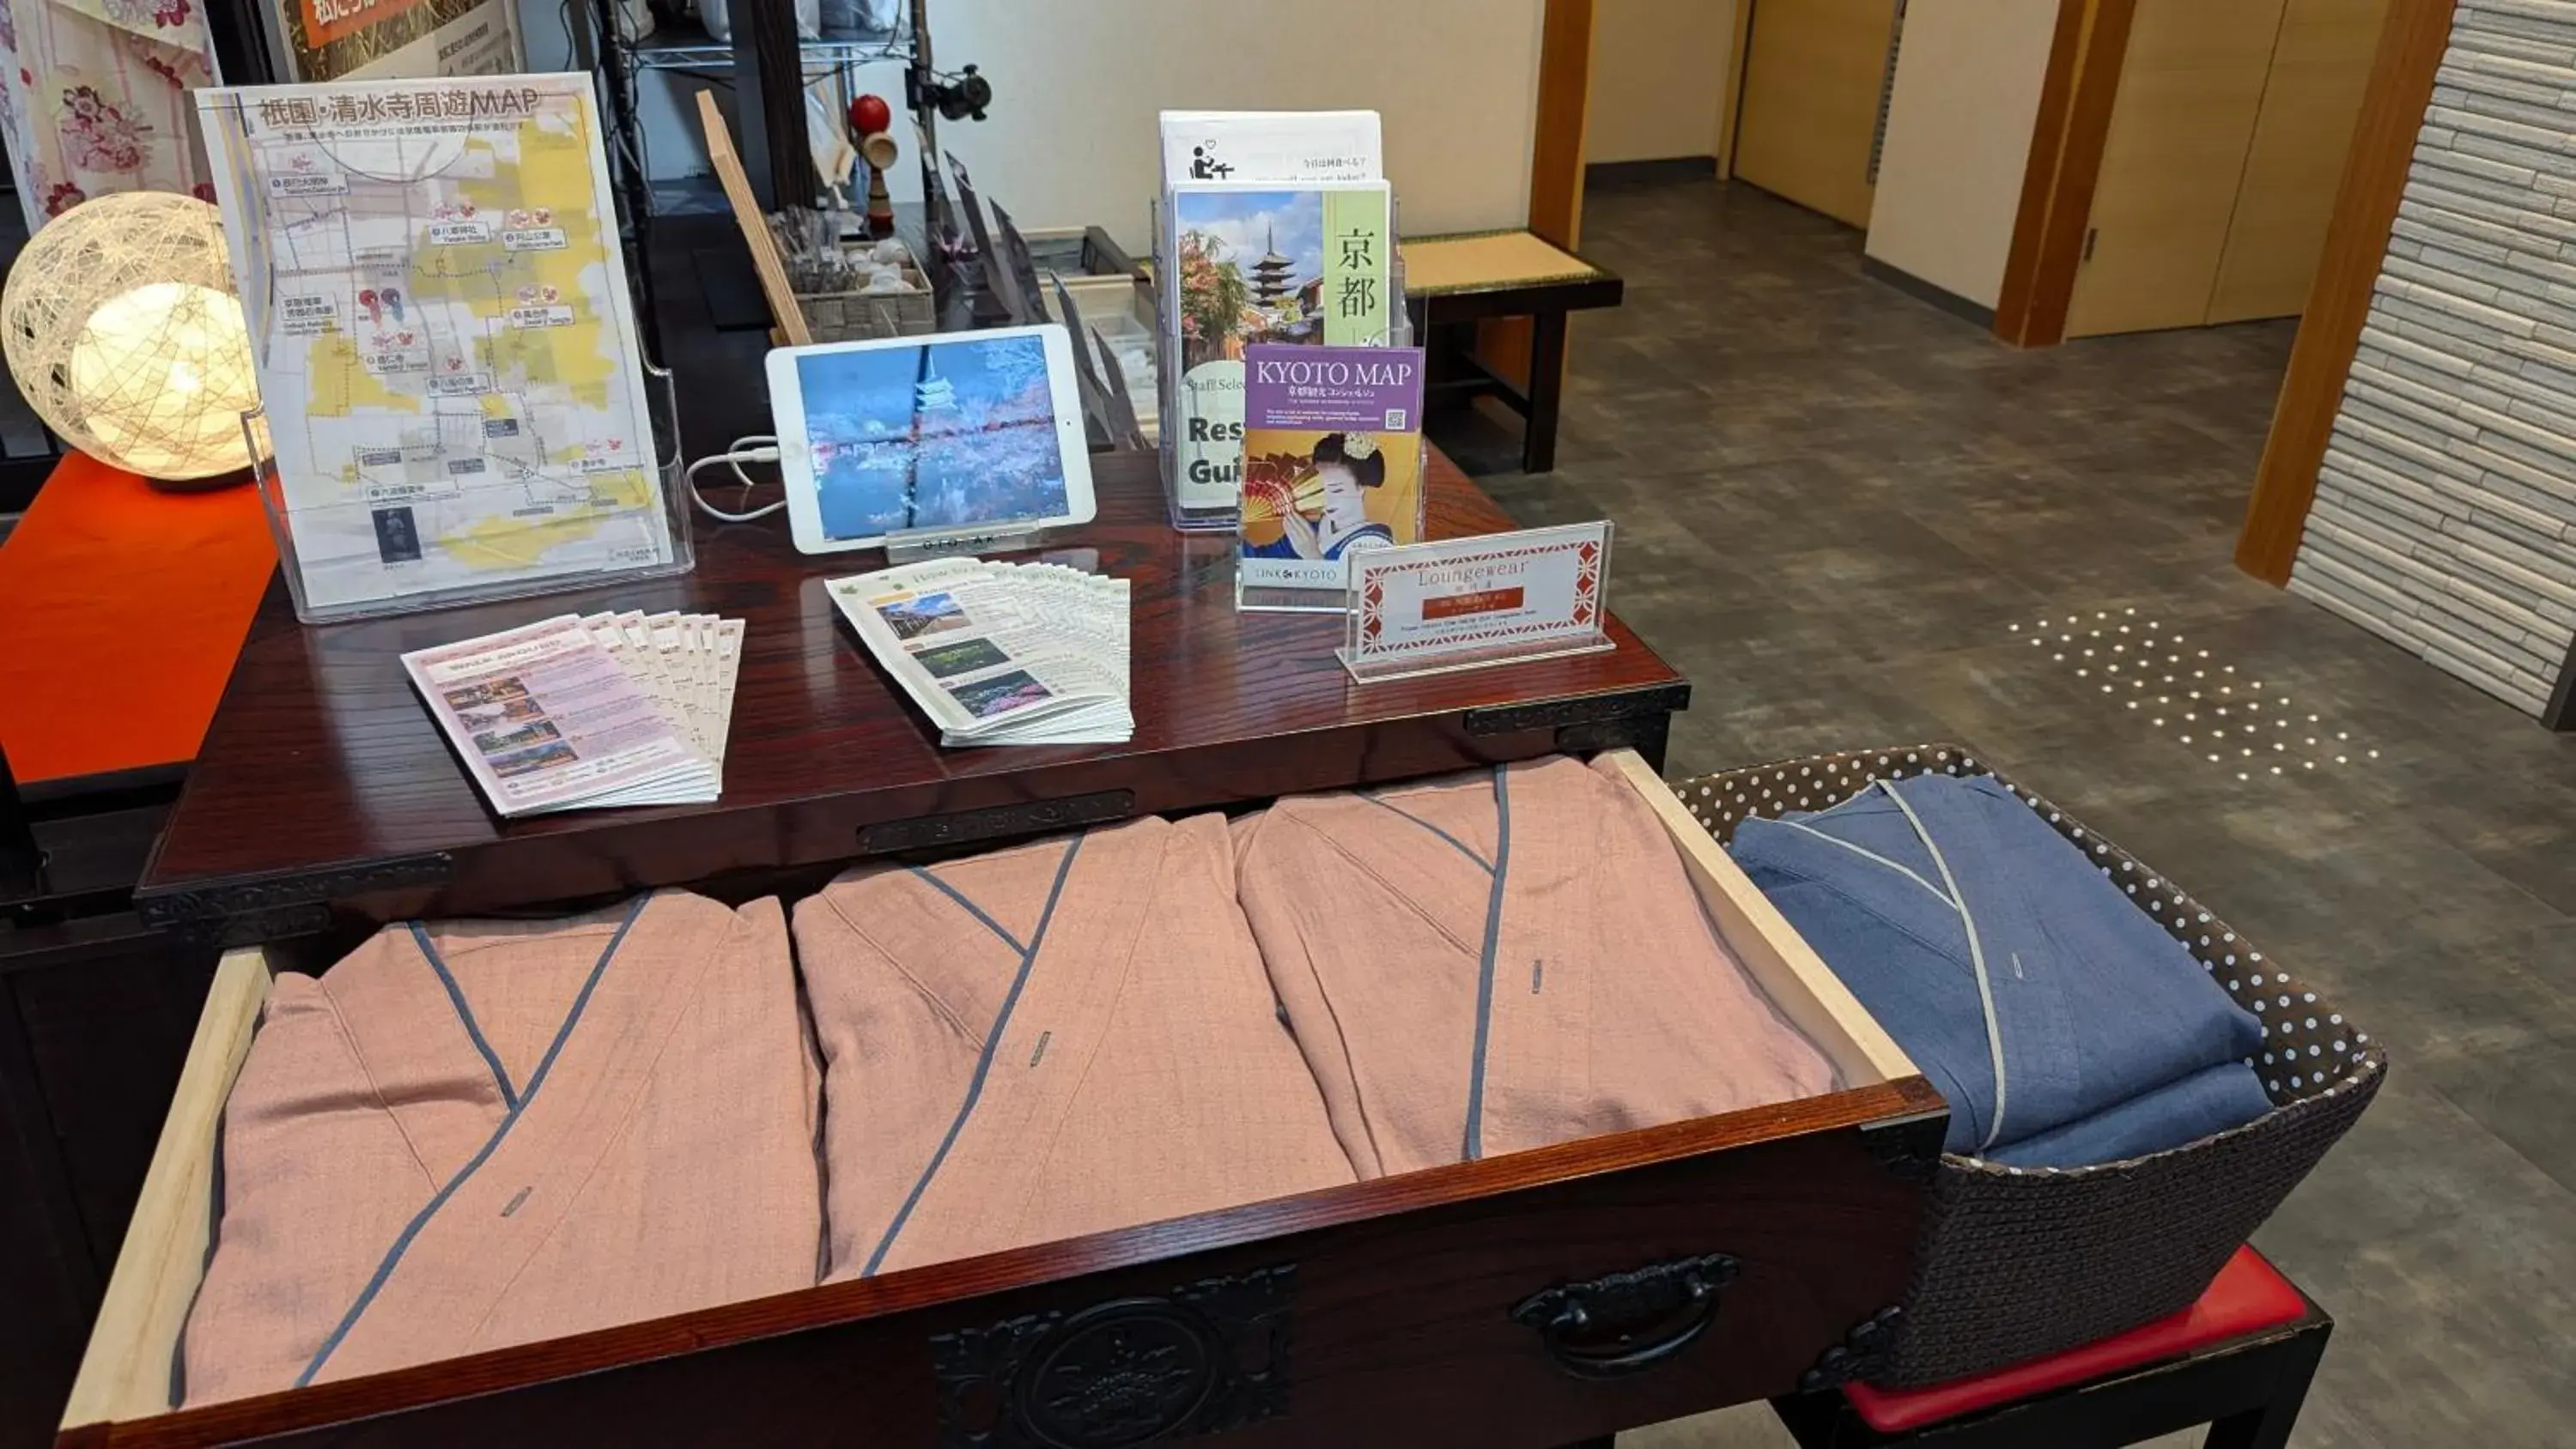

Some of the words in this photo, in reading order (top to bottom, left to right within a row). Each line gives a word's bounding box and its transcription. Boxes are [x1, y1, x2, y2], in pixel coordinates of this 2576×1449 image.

[1336, 227, 1375, 318] 京都
[1257, 361, 1349, 385] KYOTO
[1354, 363, 1413, 385] MAP
[1295, 569, 1337, 581] KYOTO
[1419, 561, 1529, 586] Loungewear
